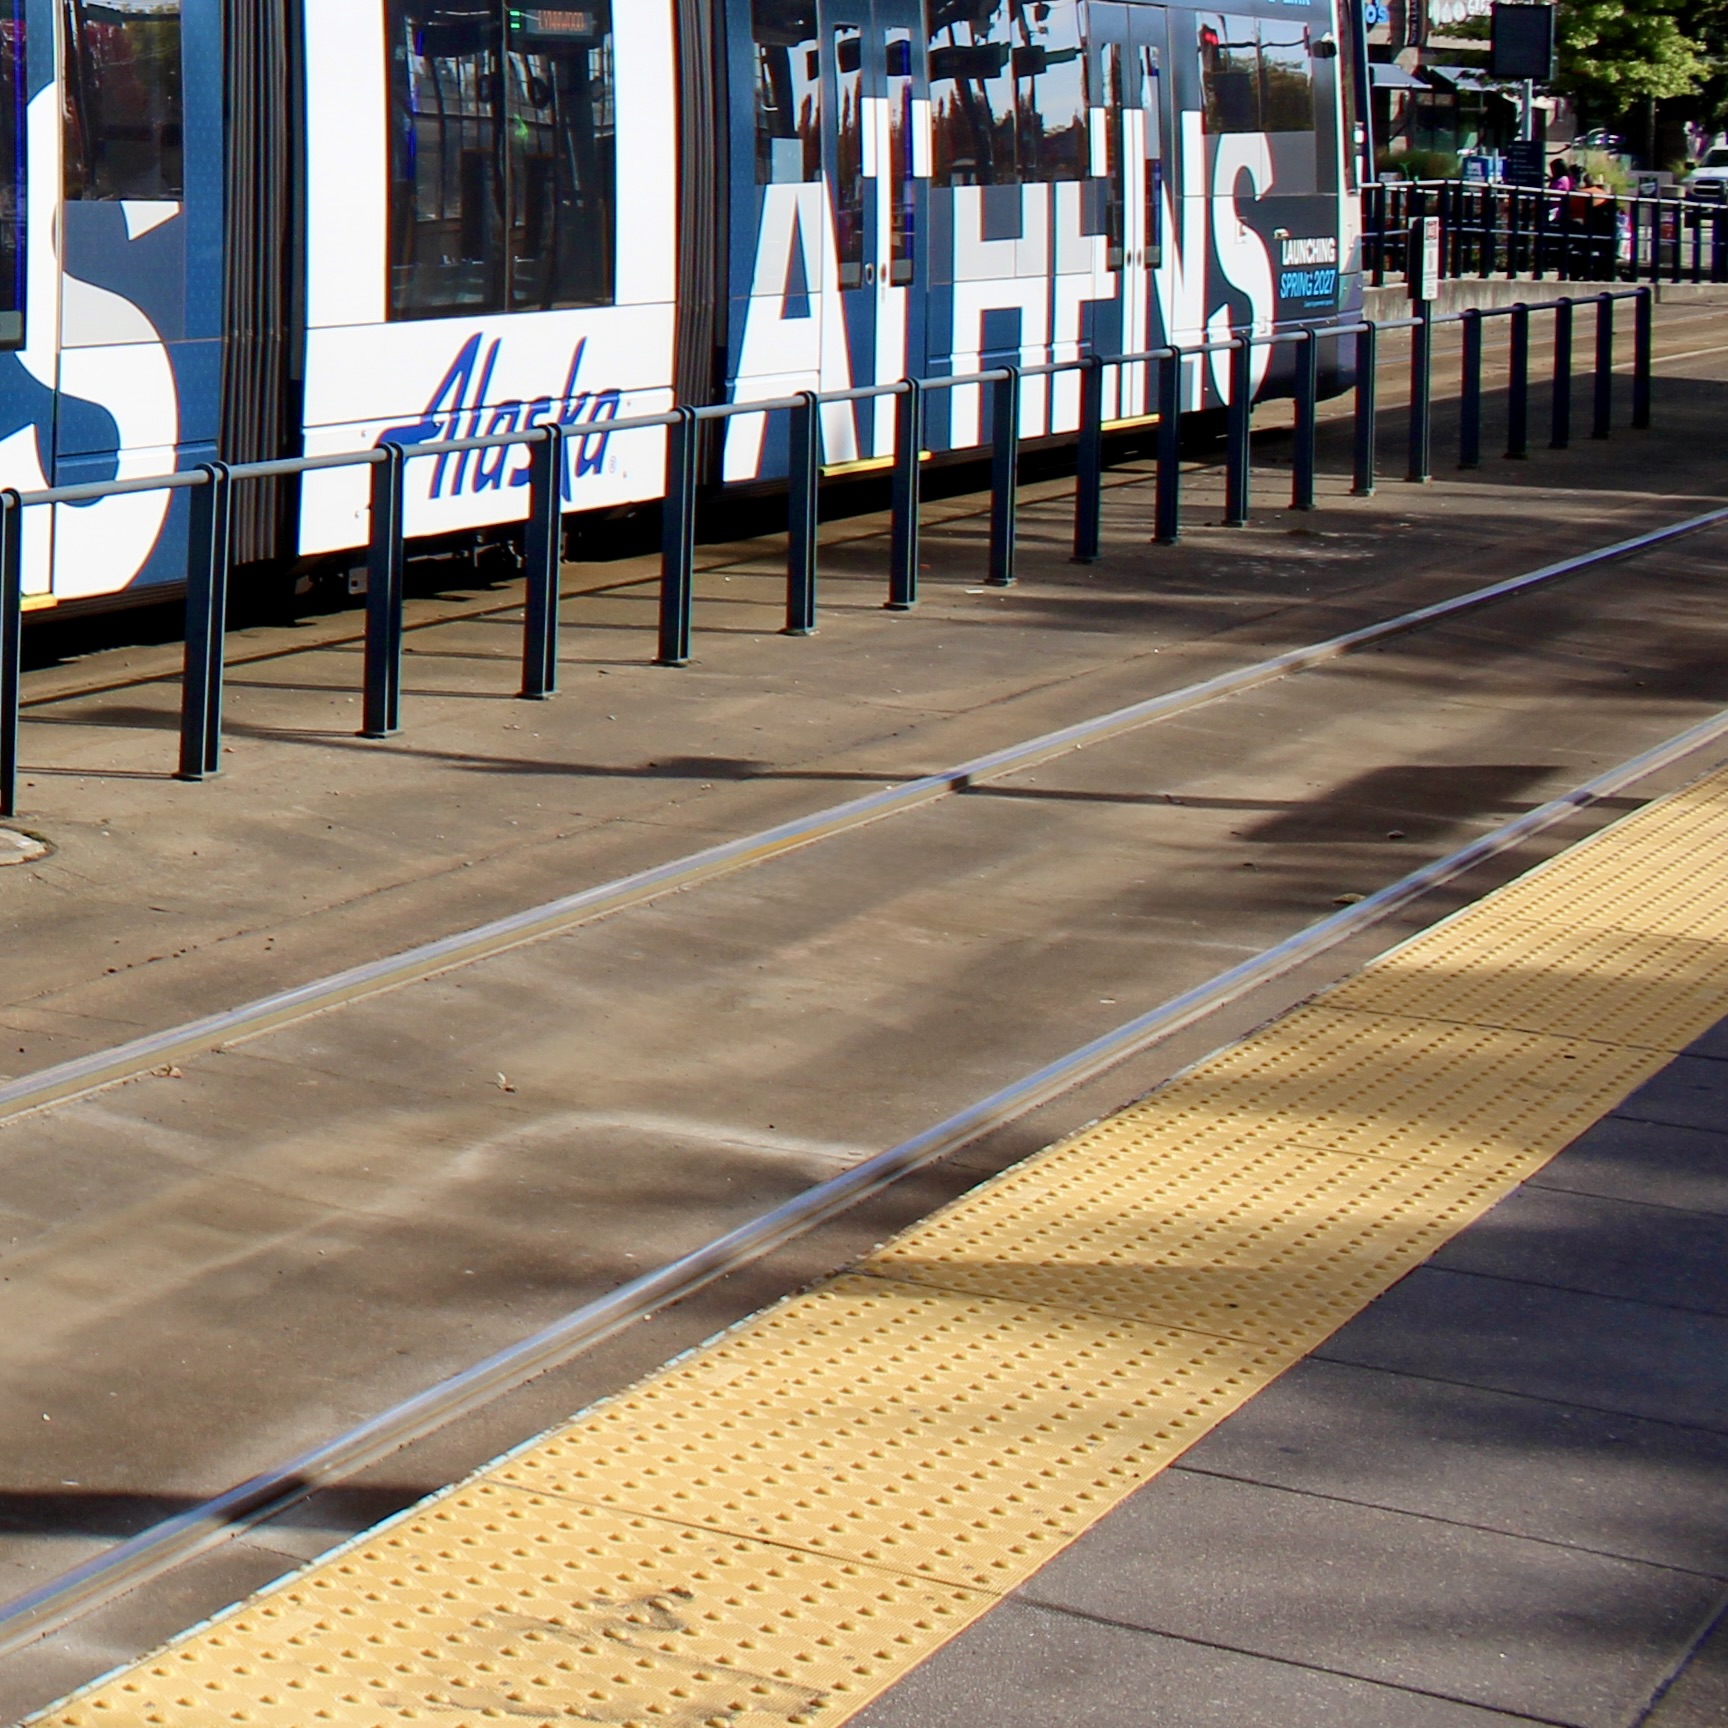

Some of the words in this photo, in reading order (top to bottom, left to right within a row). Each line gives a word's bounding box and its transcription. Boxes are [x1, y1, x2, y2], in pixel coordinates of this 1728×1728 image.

[1281, 237, 1336, 266] LAUNCHING
[1280, 271, 1313, 298] SPRING
[1313, 269, 1336, 295] 2027
